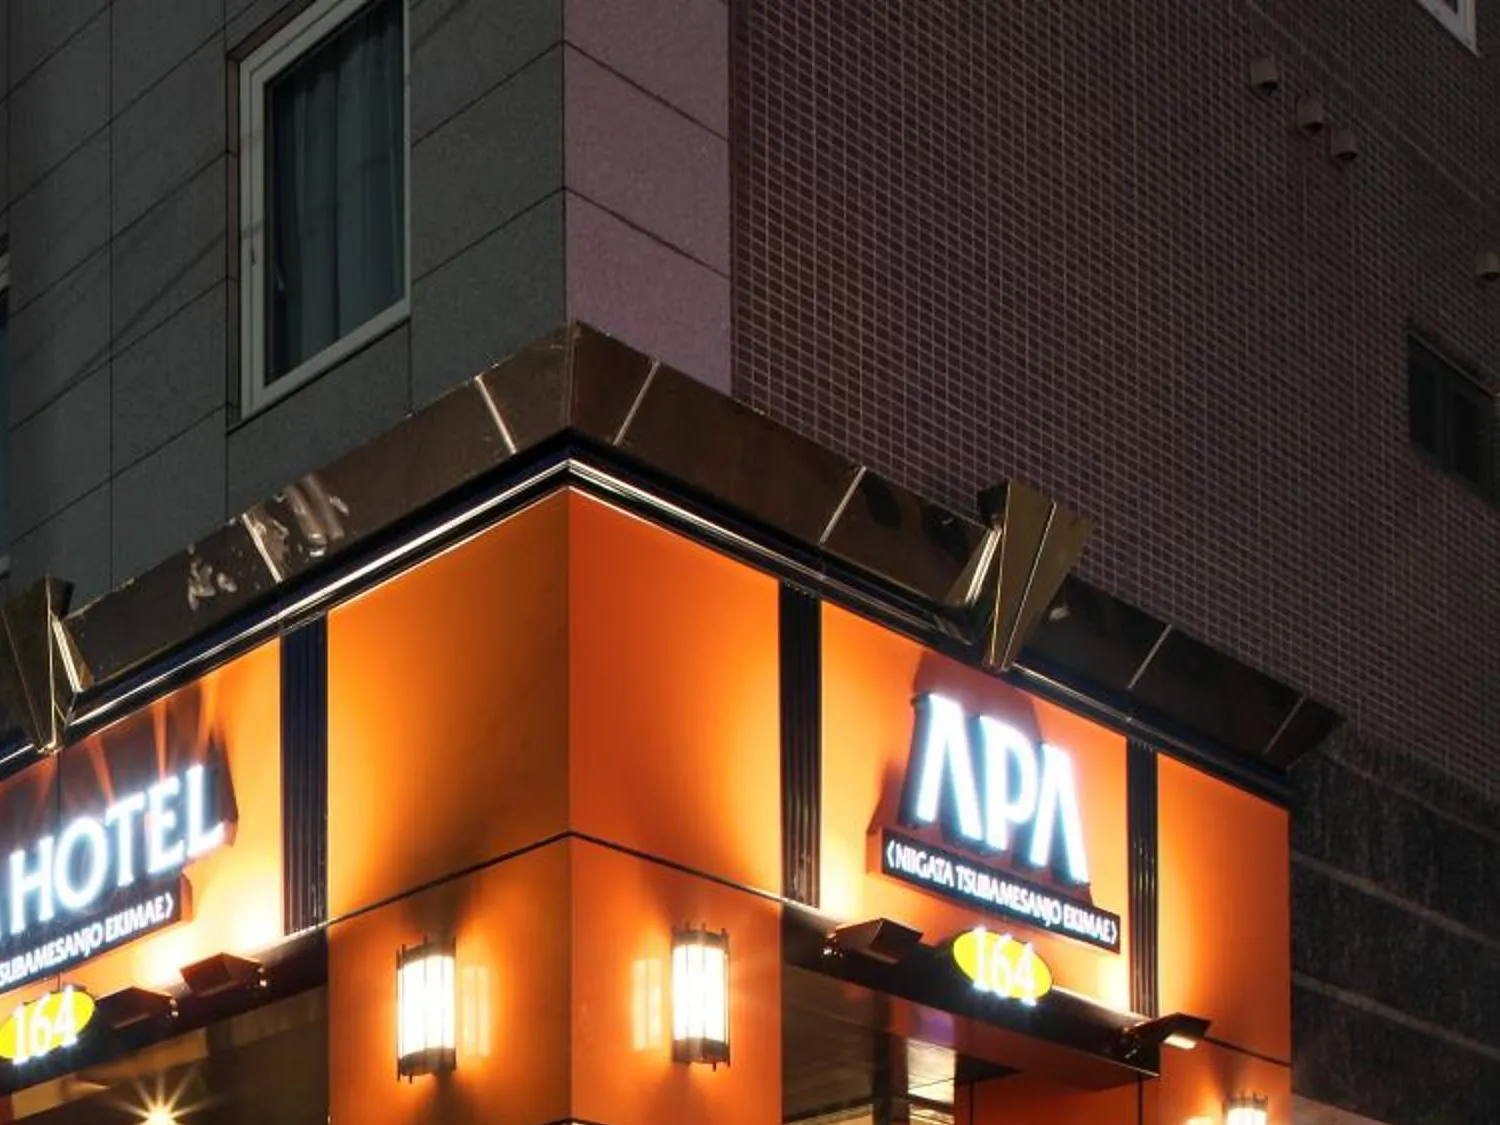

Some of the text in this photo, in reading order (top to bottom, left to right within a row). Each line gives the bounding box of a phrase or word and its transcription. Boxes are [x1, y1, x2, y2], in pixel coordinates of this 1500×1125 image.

[916, 692, 1091, 884] APA
[10, 764, 225, 935] HOTEL
[955, 866, 1062, 927] TSUBAMESANJO
[973, 926, 1037, 1007] 164
[13, 985, 79, 1065] 164
